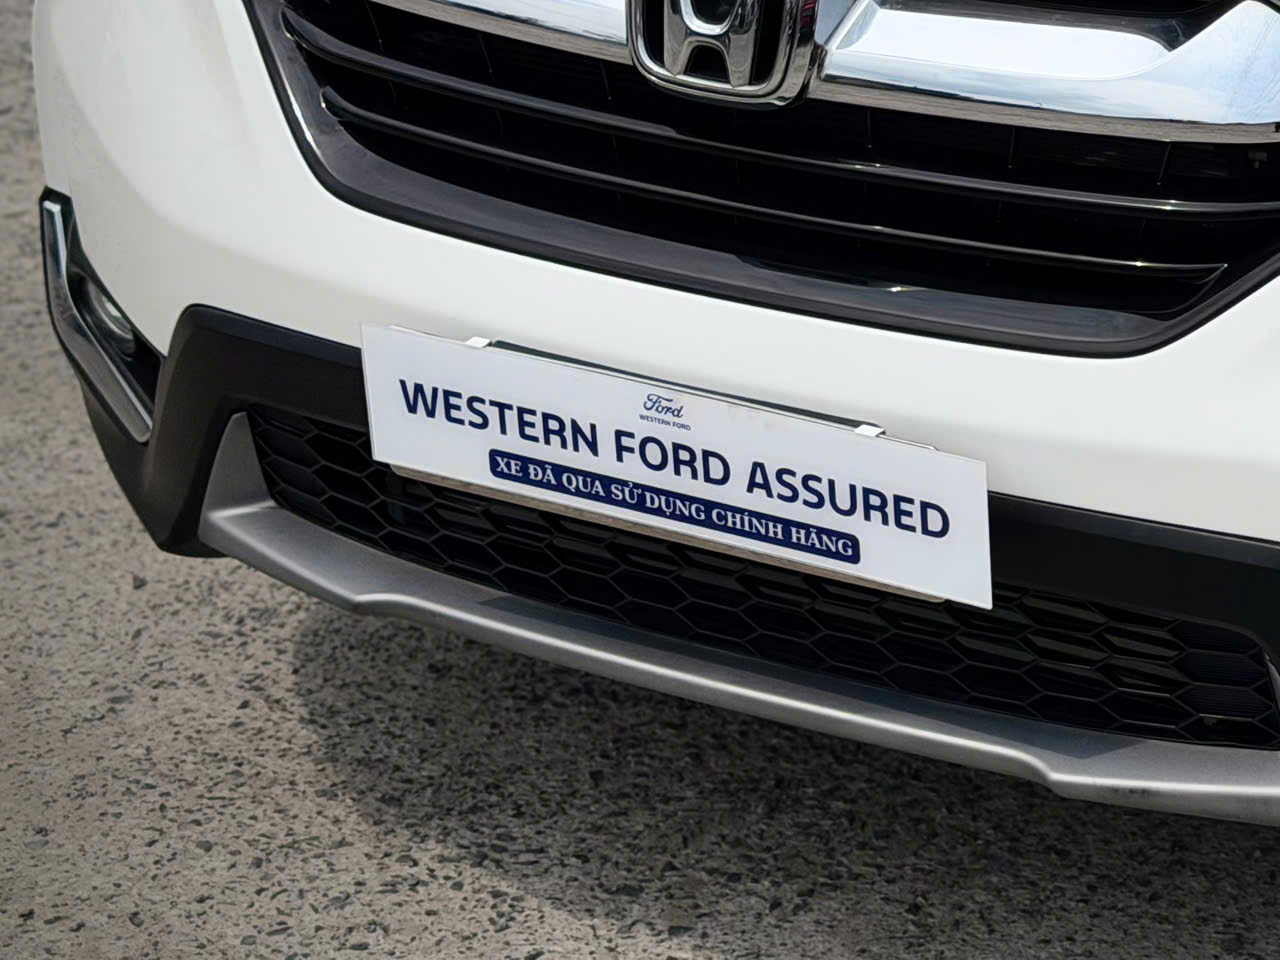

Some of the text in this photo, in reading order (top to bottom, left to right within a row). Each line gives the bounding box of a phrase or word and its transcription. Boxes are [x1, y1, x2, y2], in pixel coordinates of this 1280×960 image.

[639, 414, 691, 431] WESTERN FORD
[643, 393, 684, 418] Ford
[399, 379, 950, 539] WESTERN FORD ASSURED
[495, 456, 853, 556] XE ĐÃ QUA SỬ DỤNG CHÍNH HÃNG
